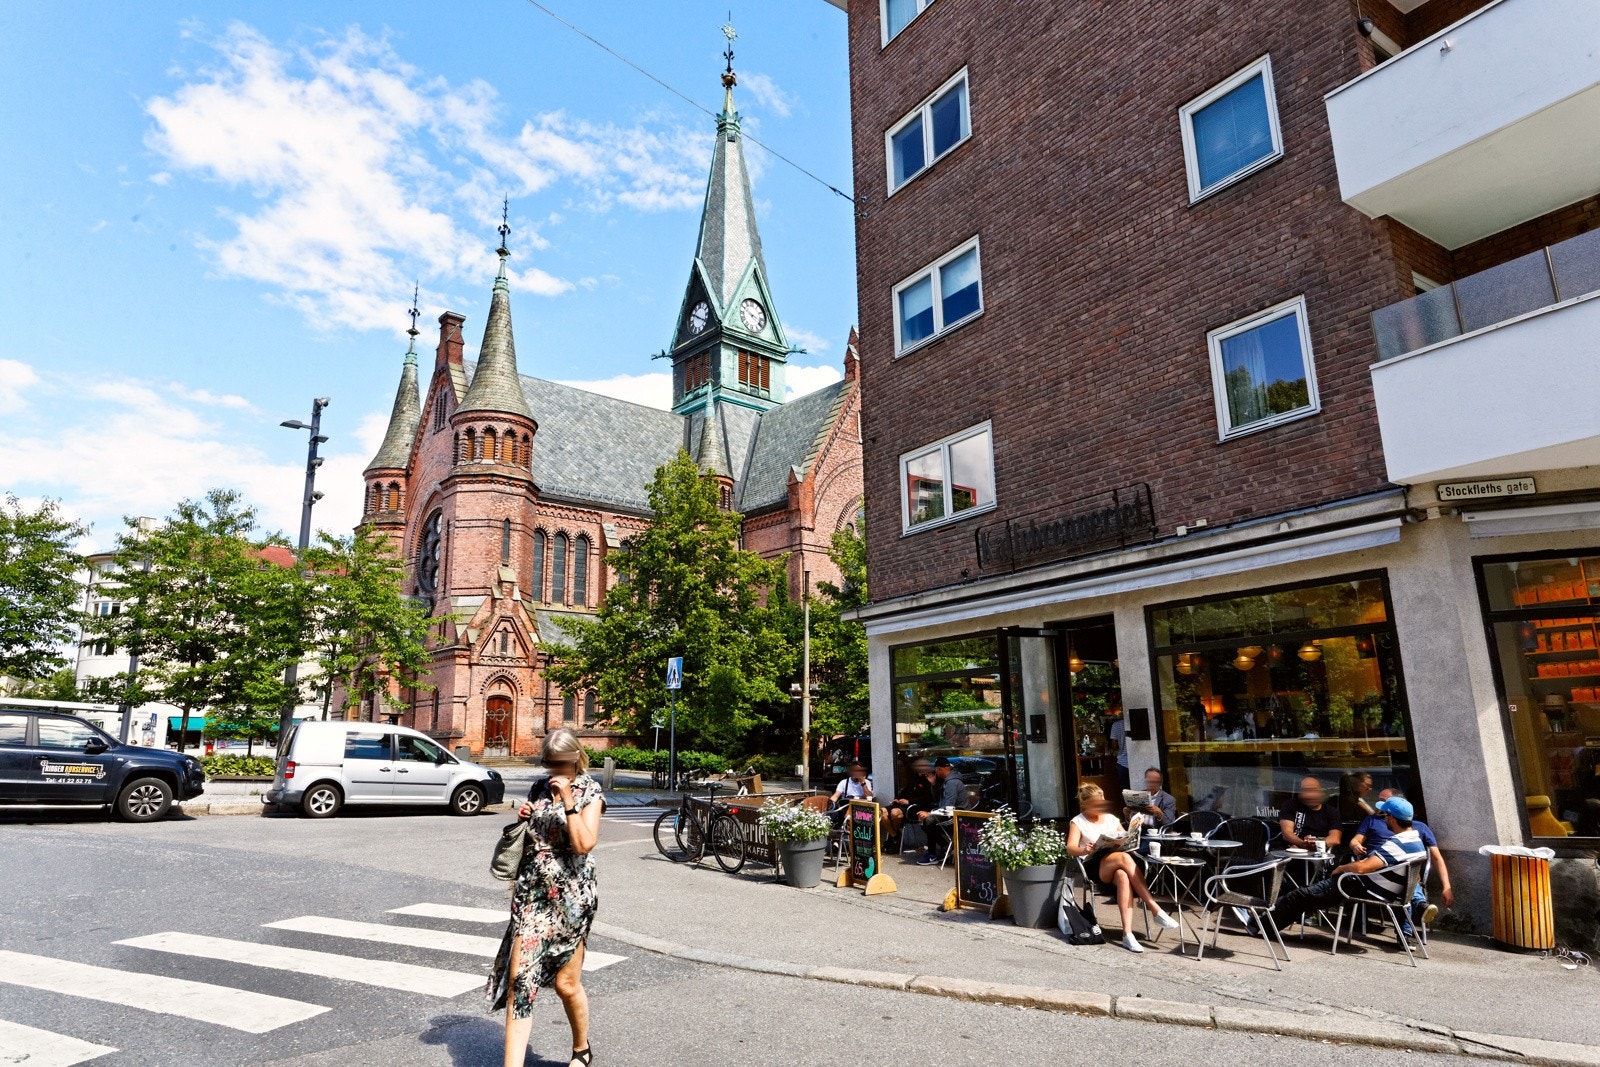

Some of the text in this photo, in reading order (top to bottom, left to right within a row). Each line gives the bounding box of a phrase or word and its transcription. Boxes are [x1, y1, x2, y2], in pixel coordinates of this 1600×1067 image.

[1445, 481, 1529, 497] Stockfleths gate
[1256, 805, 1280, 817] Kaffebr
[747, 844, 769, 858] KAFFE
